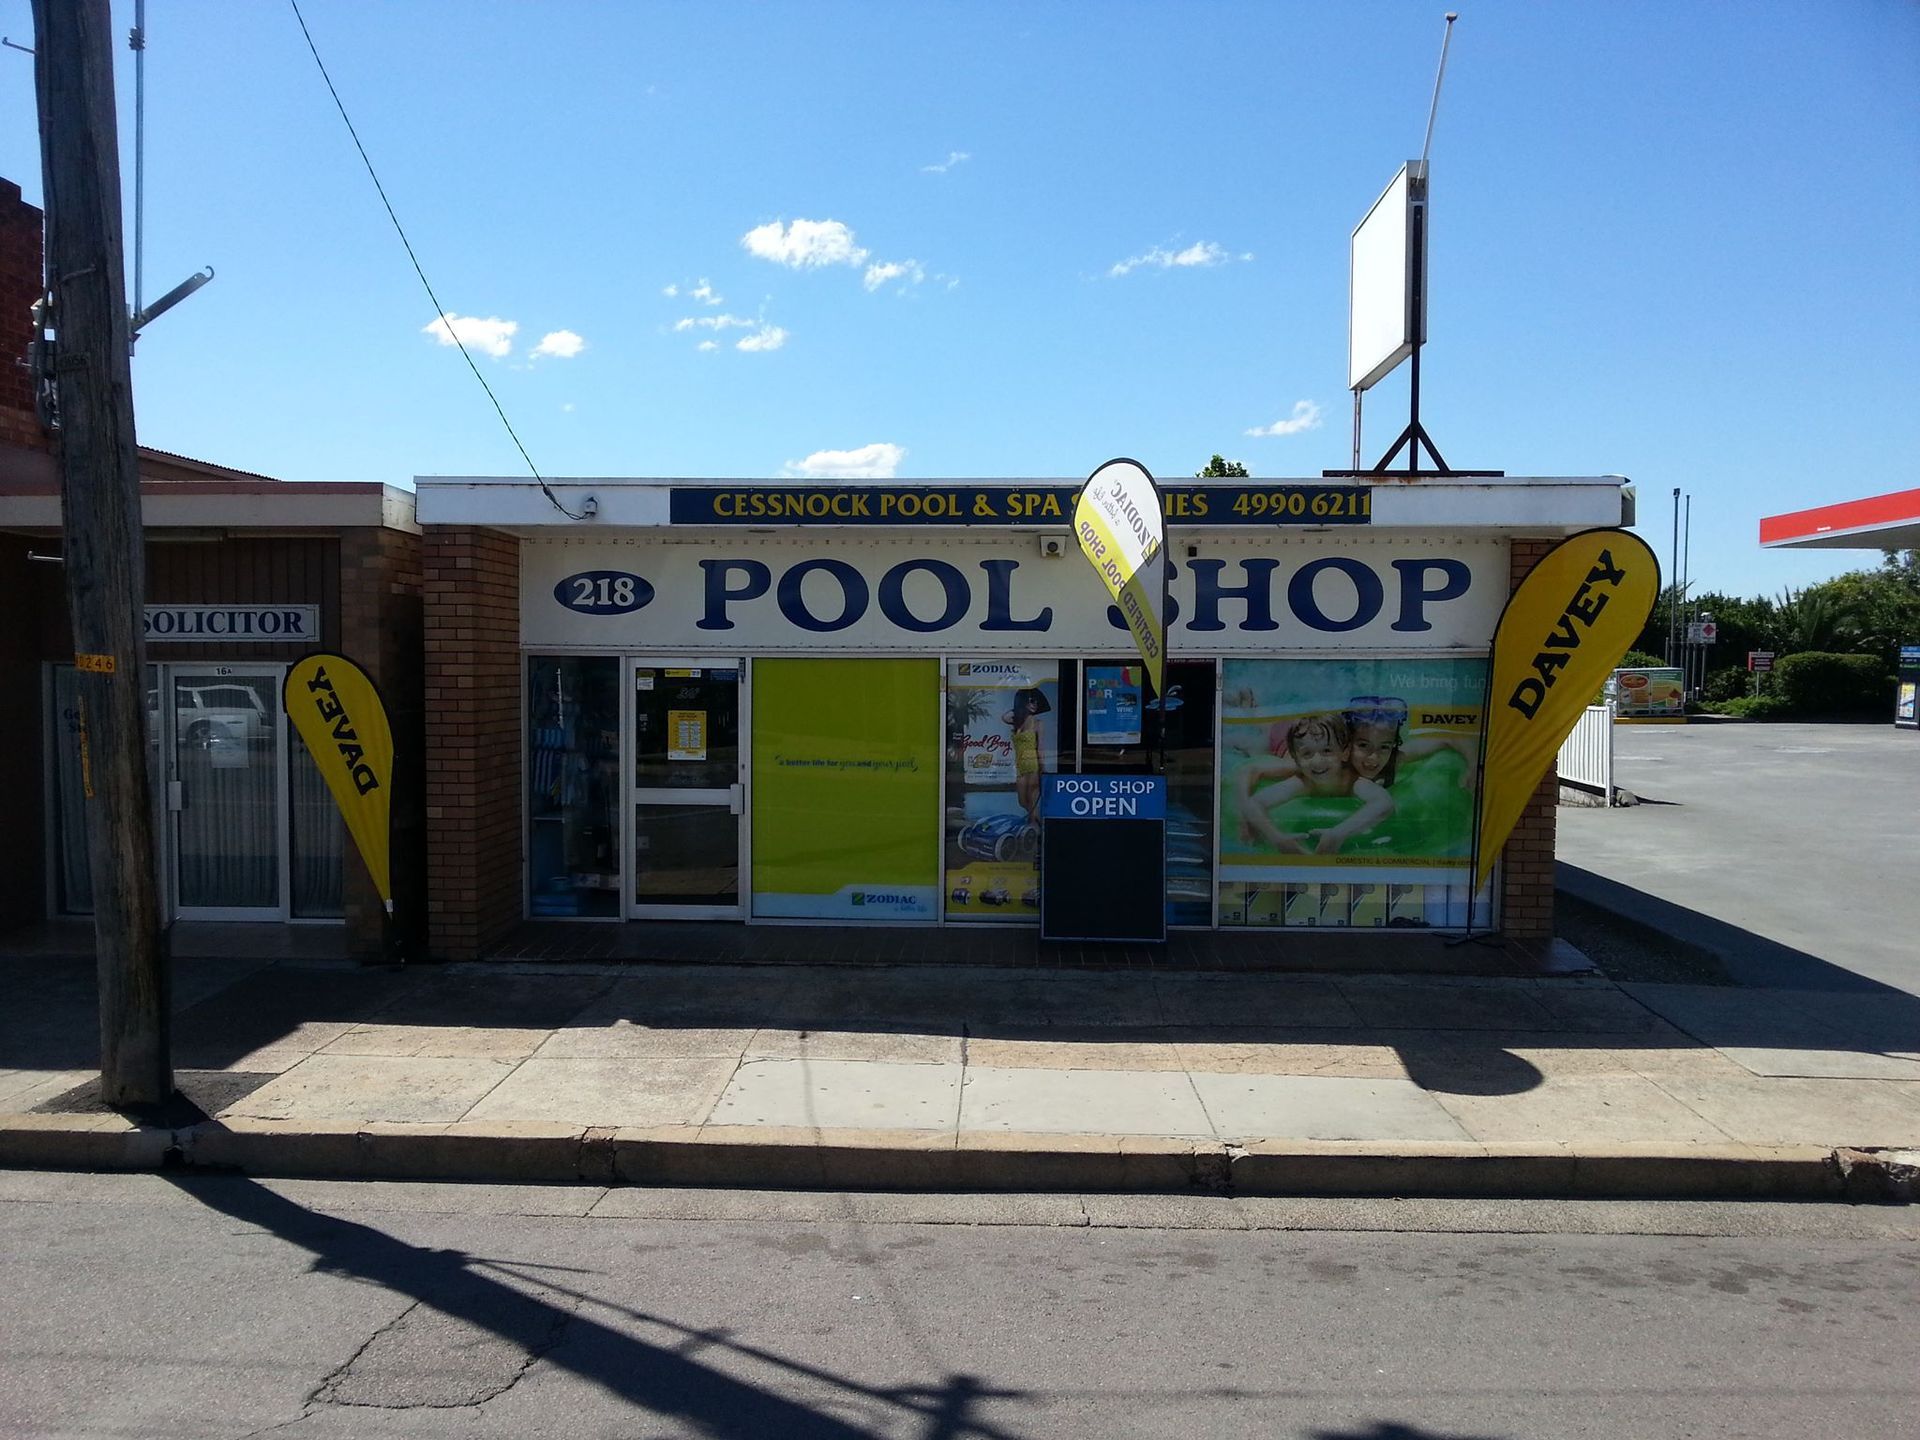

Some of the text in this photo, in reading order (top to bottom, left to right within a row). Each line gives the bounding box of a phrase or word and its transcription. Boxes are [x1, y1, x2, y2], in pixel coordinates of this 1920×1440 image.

[712, 493, 871, 517] CESSNOCK
[880, 493, 963, 517] POOL
[972, 493, 998, 517] &
[1006, 493, 1061, 517] SPA
[1231, 492, 1306, 517] 4990
[1311, 492, 1372, 517] 6211
[571, 576, 636, 607] 218
[695, 557, 1053, 633] POOL
[1508, 548, 1626, 720] DAVEY
[216, 666, 232, 676] 16A
[972, 664, 1020, 674] ZODIAC
[1389, 673, 1414, 689] We
[1420, 672, 1458, 691] bring
[1421, 713, 1478, 725] DAVEY
[960, 734, 988, 750] Good
[986, 734, 1013, 757] Boy
[1056, 780, 1155, 794] POOL SHOP
[1071, 796, 1137, 816] OPEN
[866, 894, 916, 905] ZODIAC
